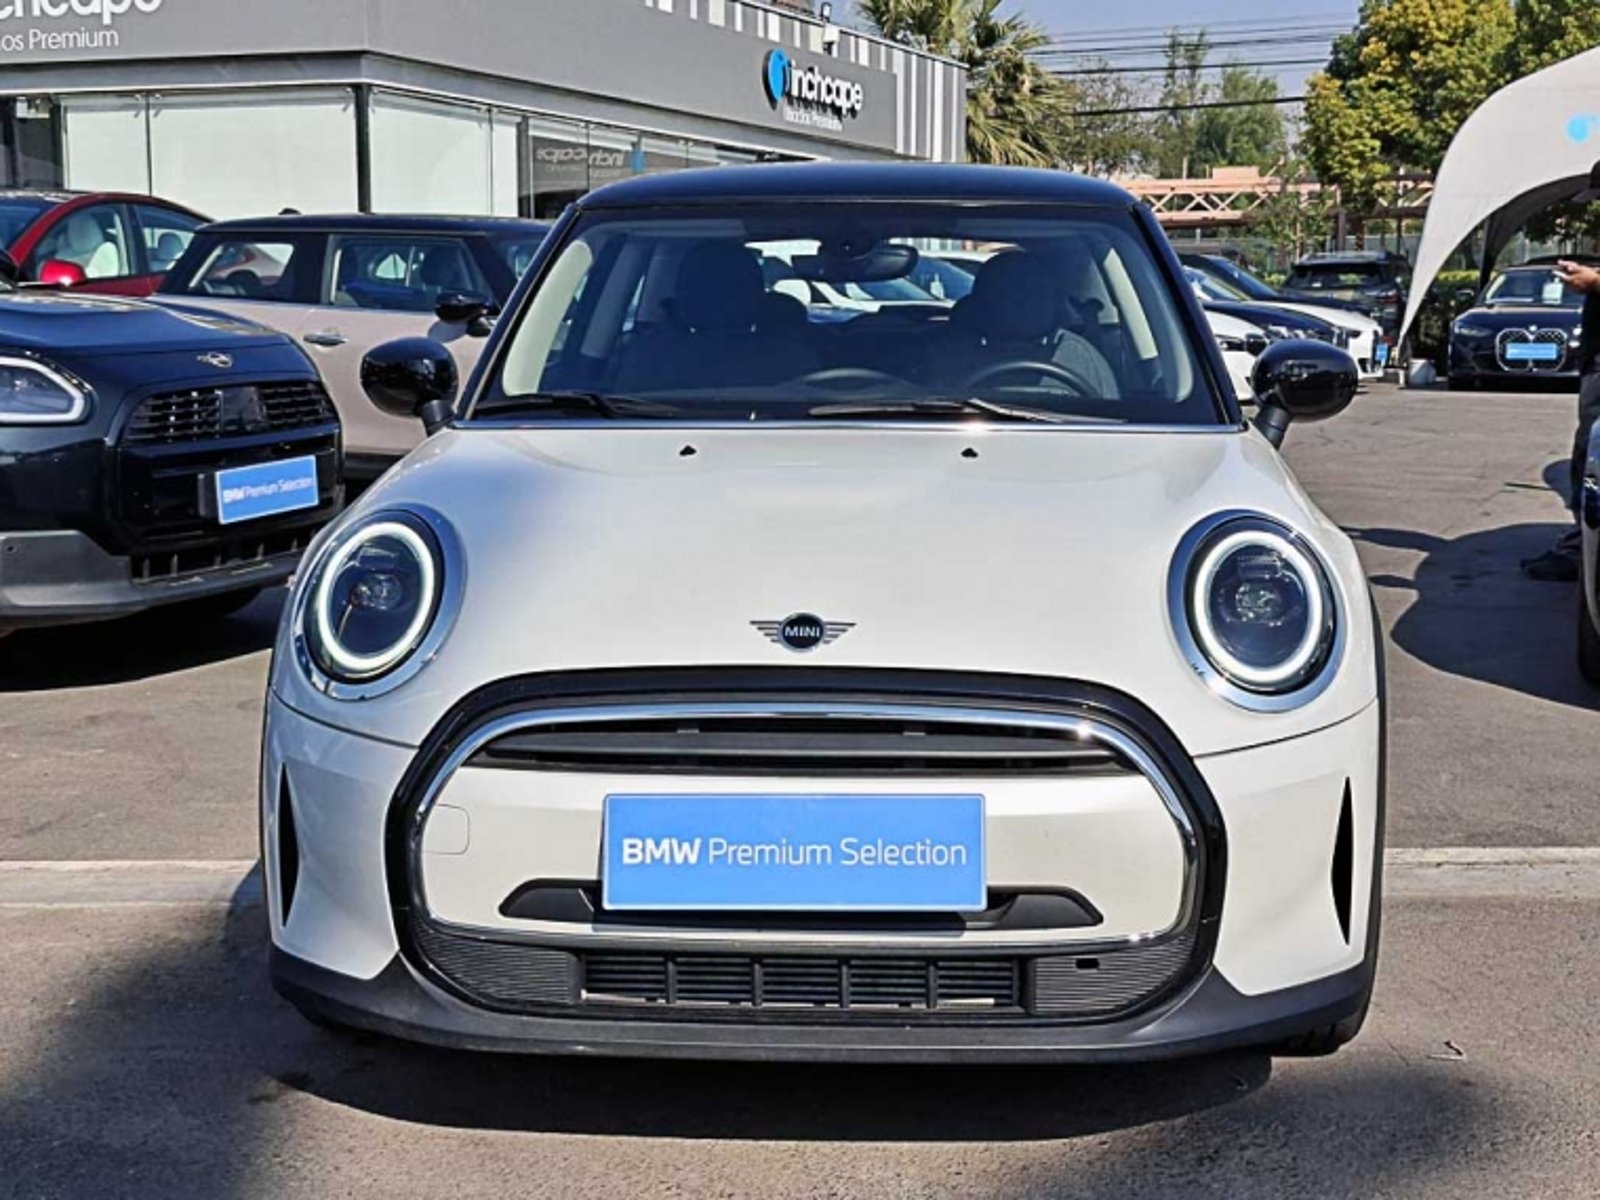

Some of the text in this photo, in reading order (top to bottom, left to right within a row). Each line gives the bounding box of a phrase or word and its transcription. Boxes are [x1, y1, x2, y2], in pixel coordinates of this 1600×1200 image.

[28, 27, 119, 50] Premium
[791, 59, 864, 114] inchcape
[785, 626, 820, 637] MINI
[622, 837, 967, 866] BMW Premium Selection
